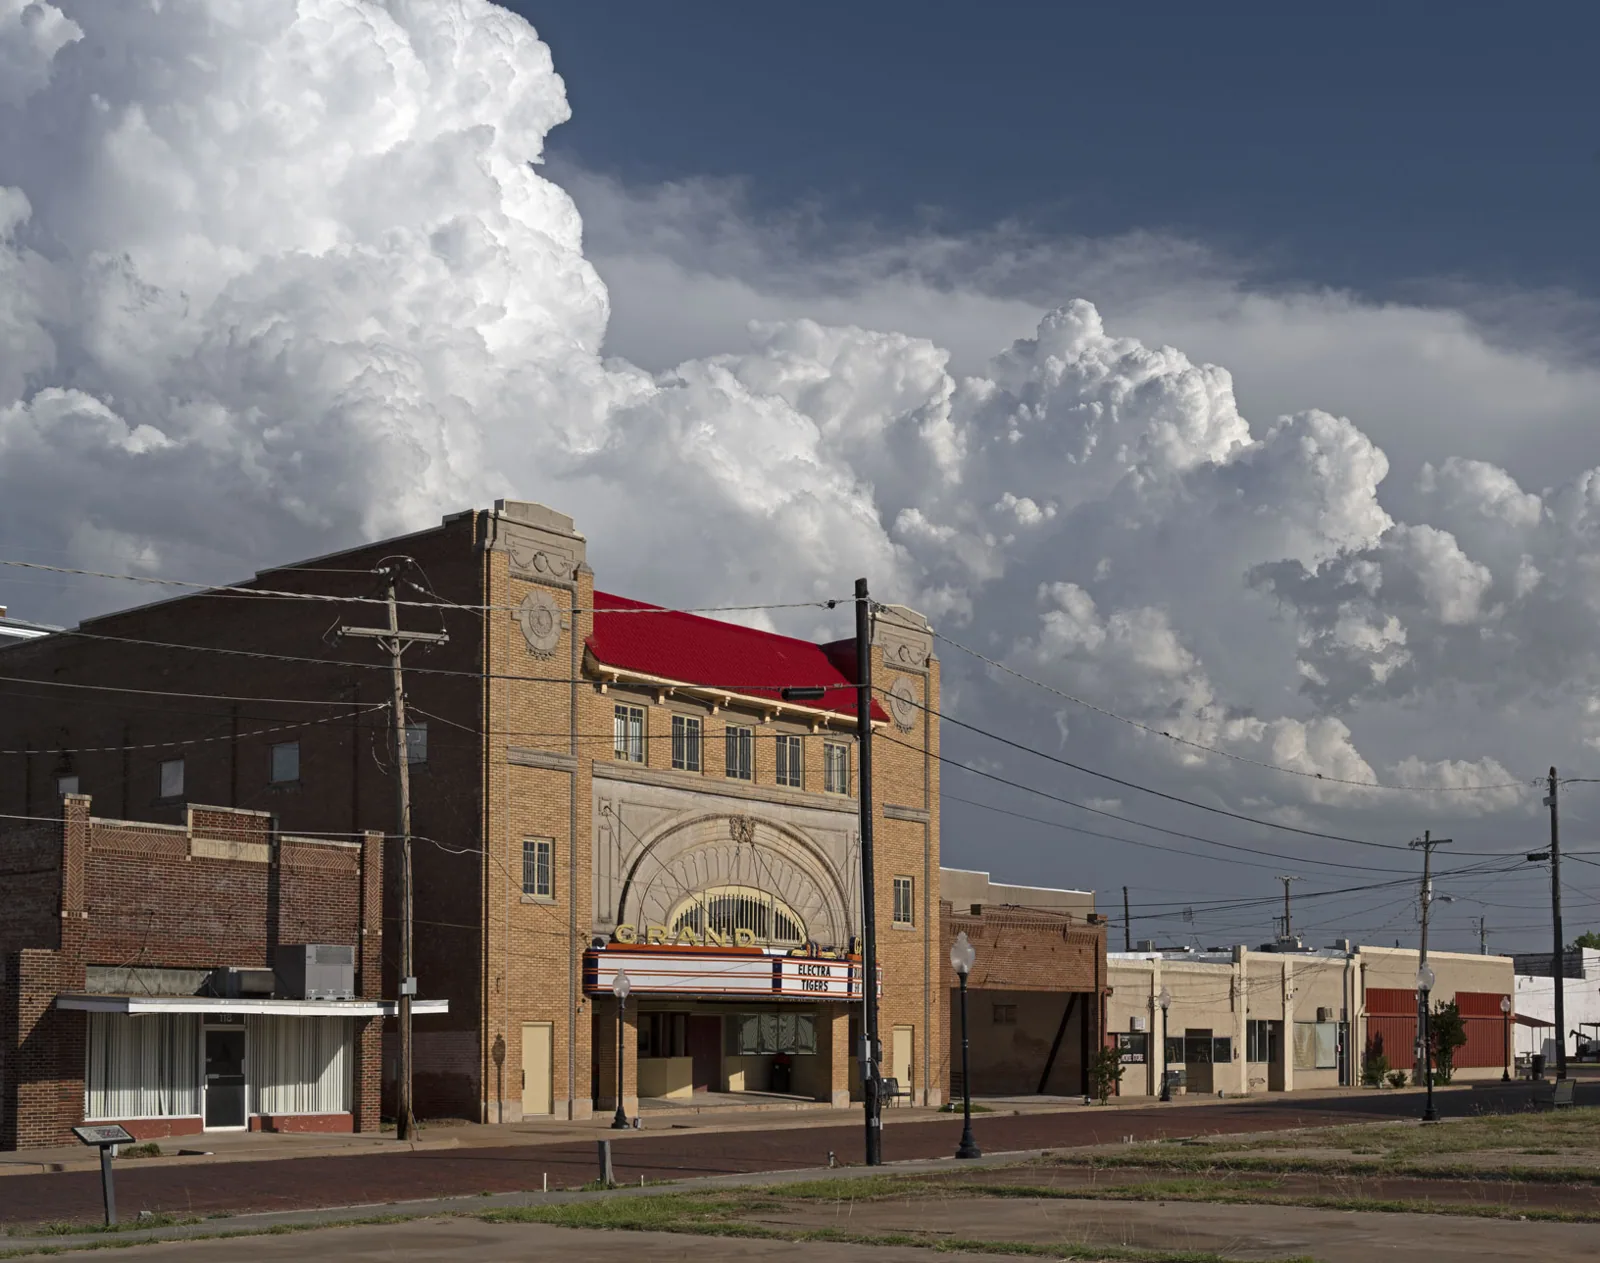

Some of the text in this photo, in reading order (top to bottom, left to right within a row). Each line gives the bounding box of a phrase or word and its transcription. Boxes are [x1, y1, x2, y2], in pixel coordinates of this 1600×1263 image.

[615, 924, 756, 948] GRAND
[798, 964, 831, 977] ELECTRA
[801, 980, 829, 992] TIGERS
